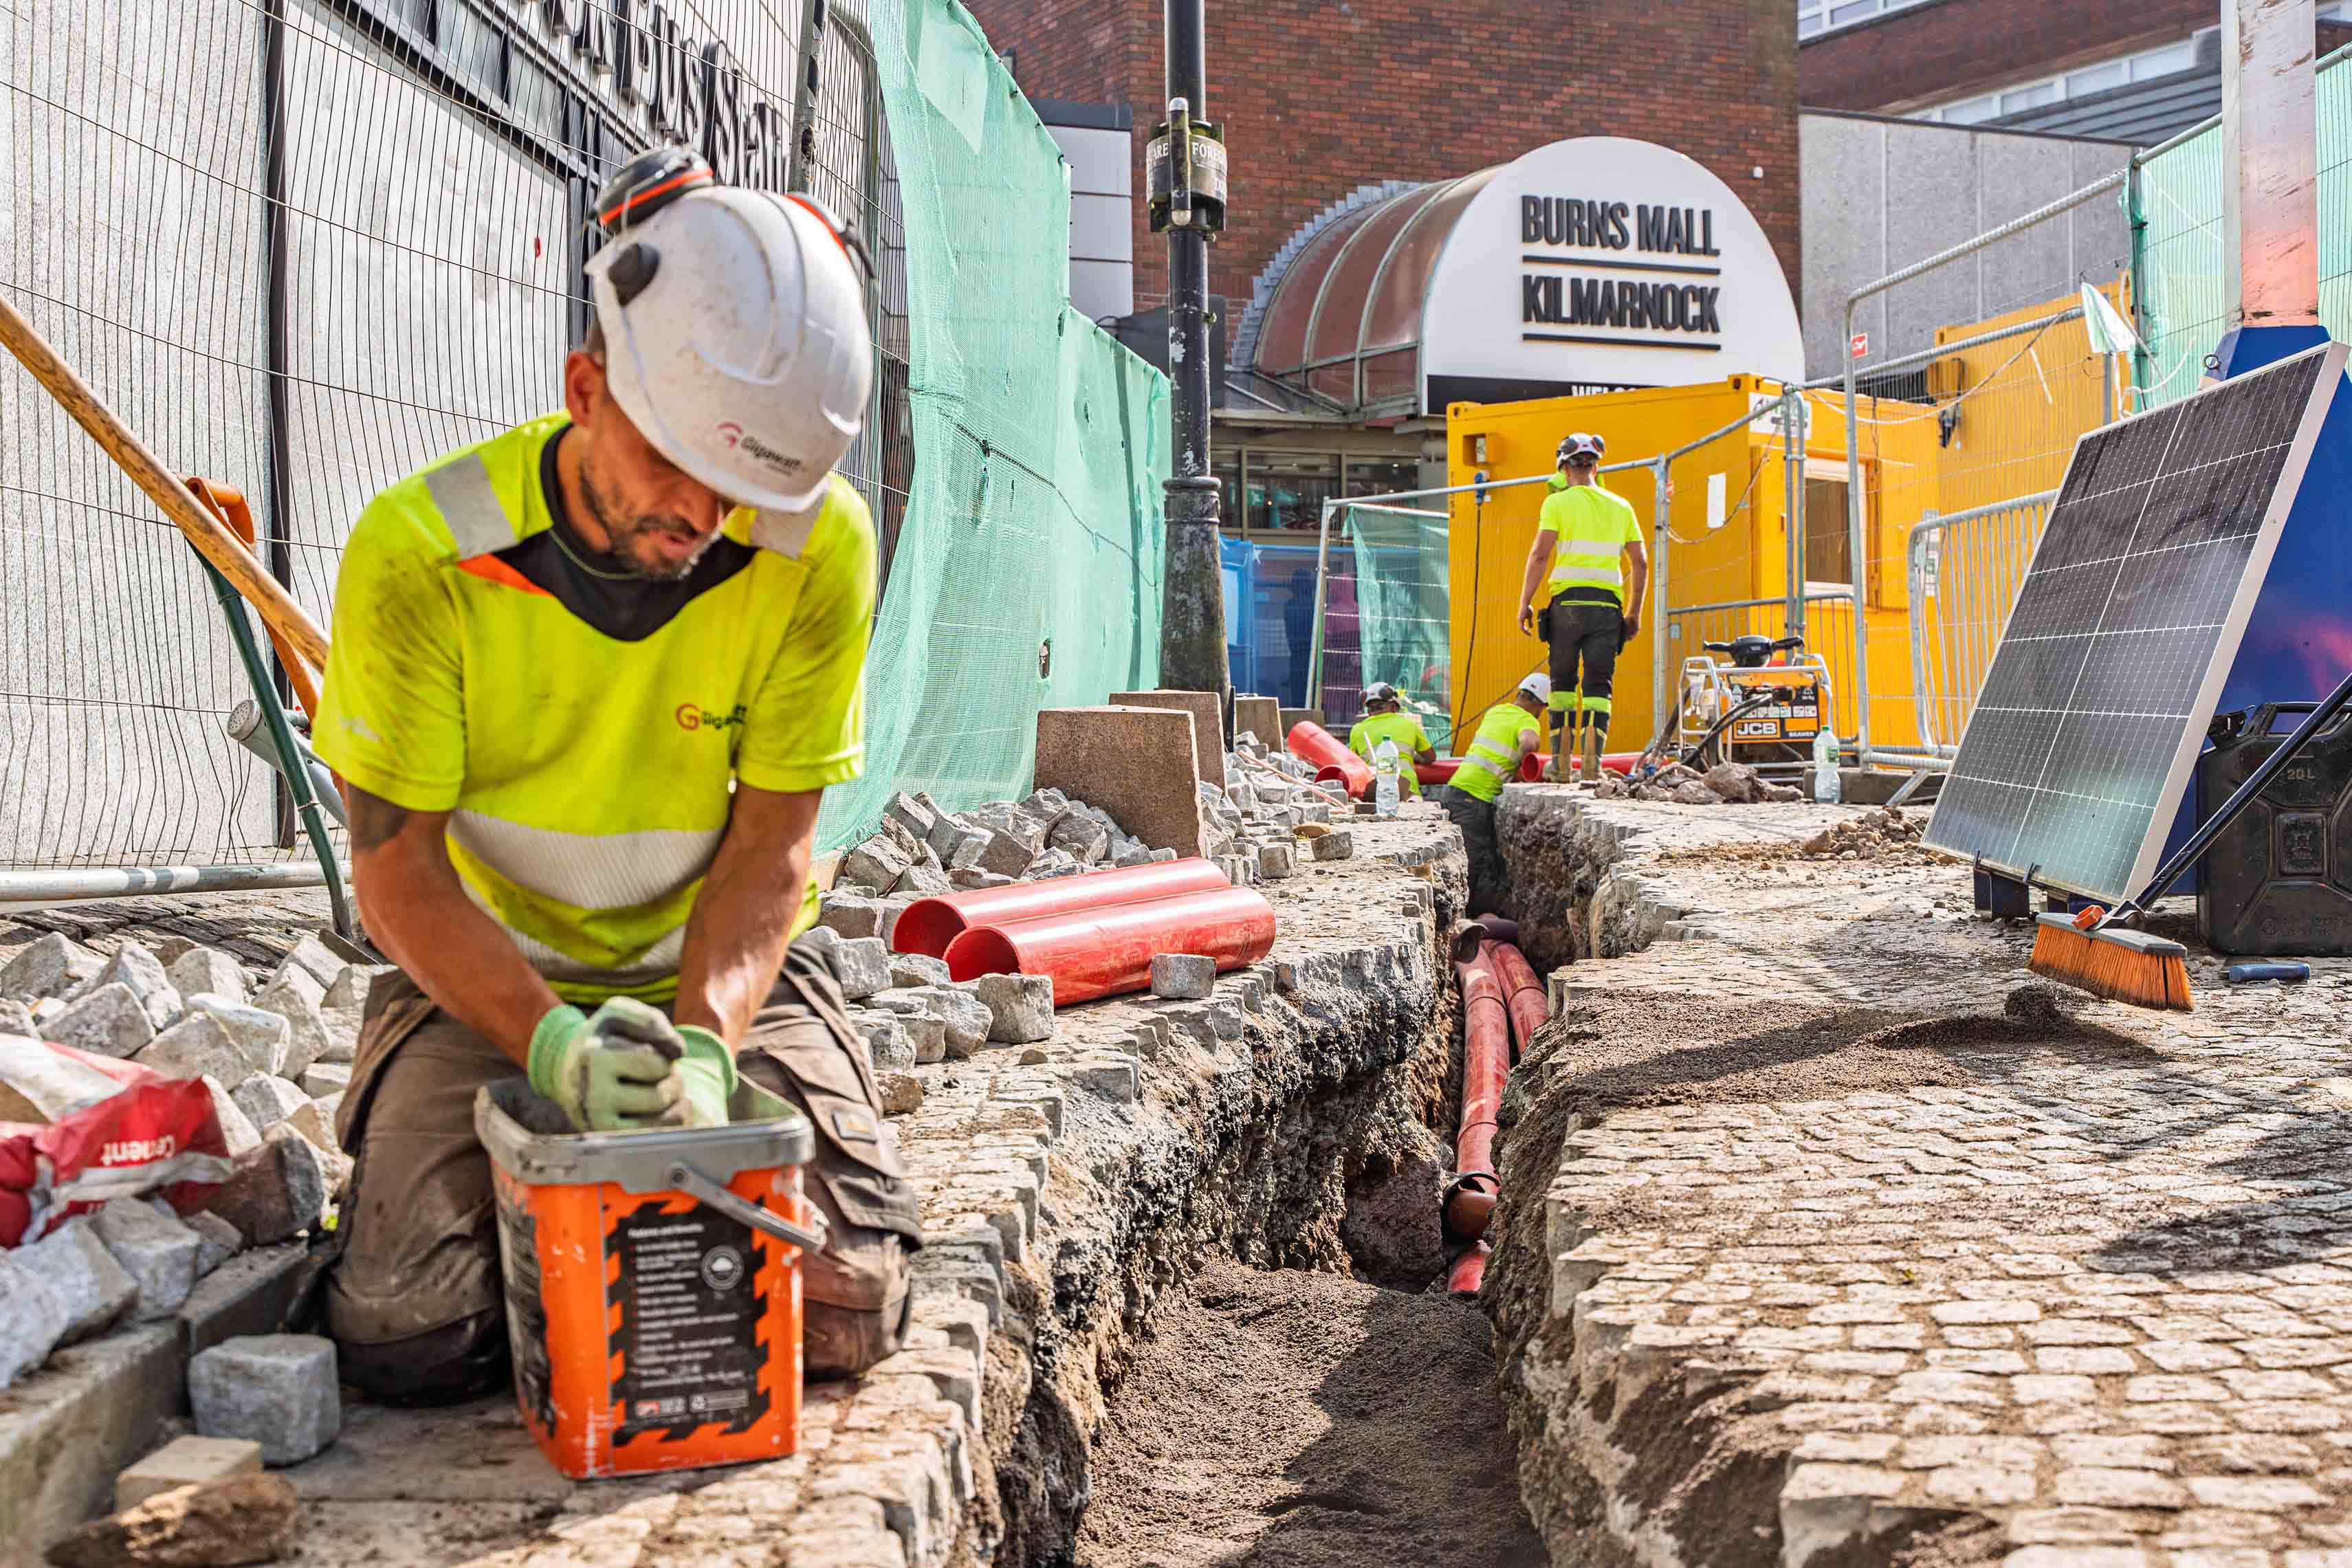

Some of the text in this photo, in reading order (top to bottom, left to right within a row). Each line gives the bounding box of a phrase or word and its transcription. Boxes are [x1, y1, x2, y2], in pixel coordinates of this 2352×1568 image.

[1521, 195, 1720, 256] BURNS MALL
[1522, 275, 1720, 333] KILMARNOCK
[1737, 722, 1777, 736] JCB
